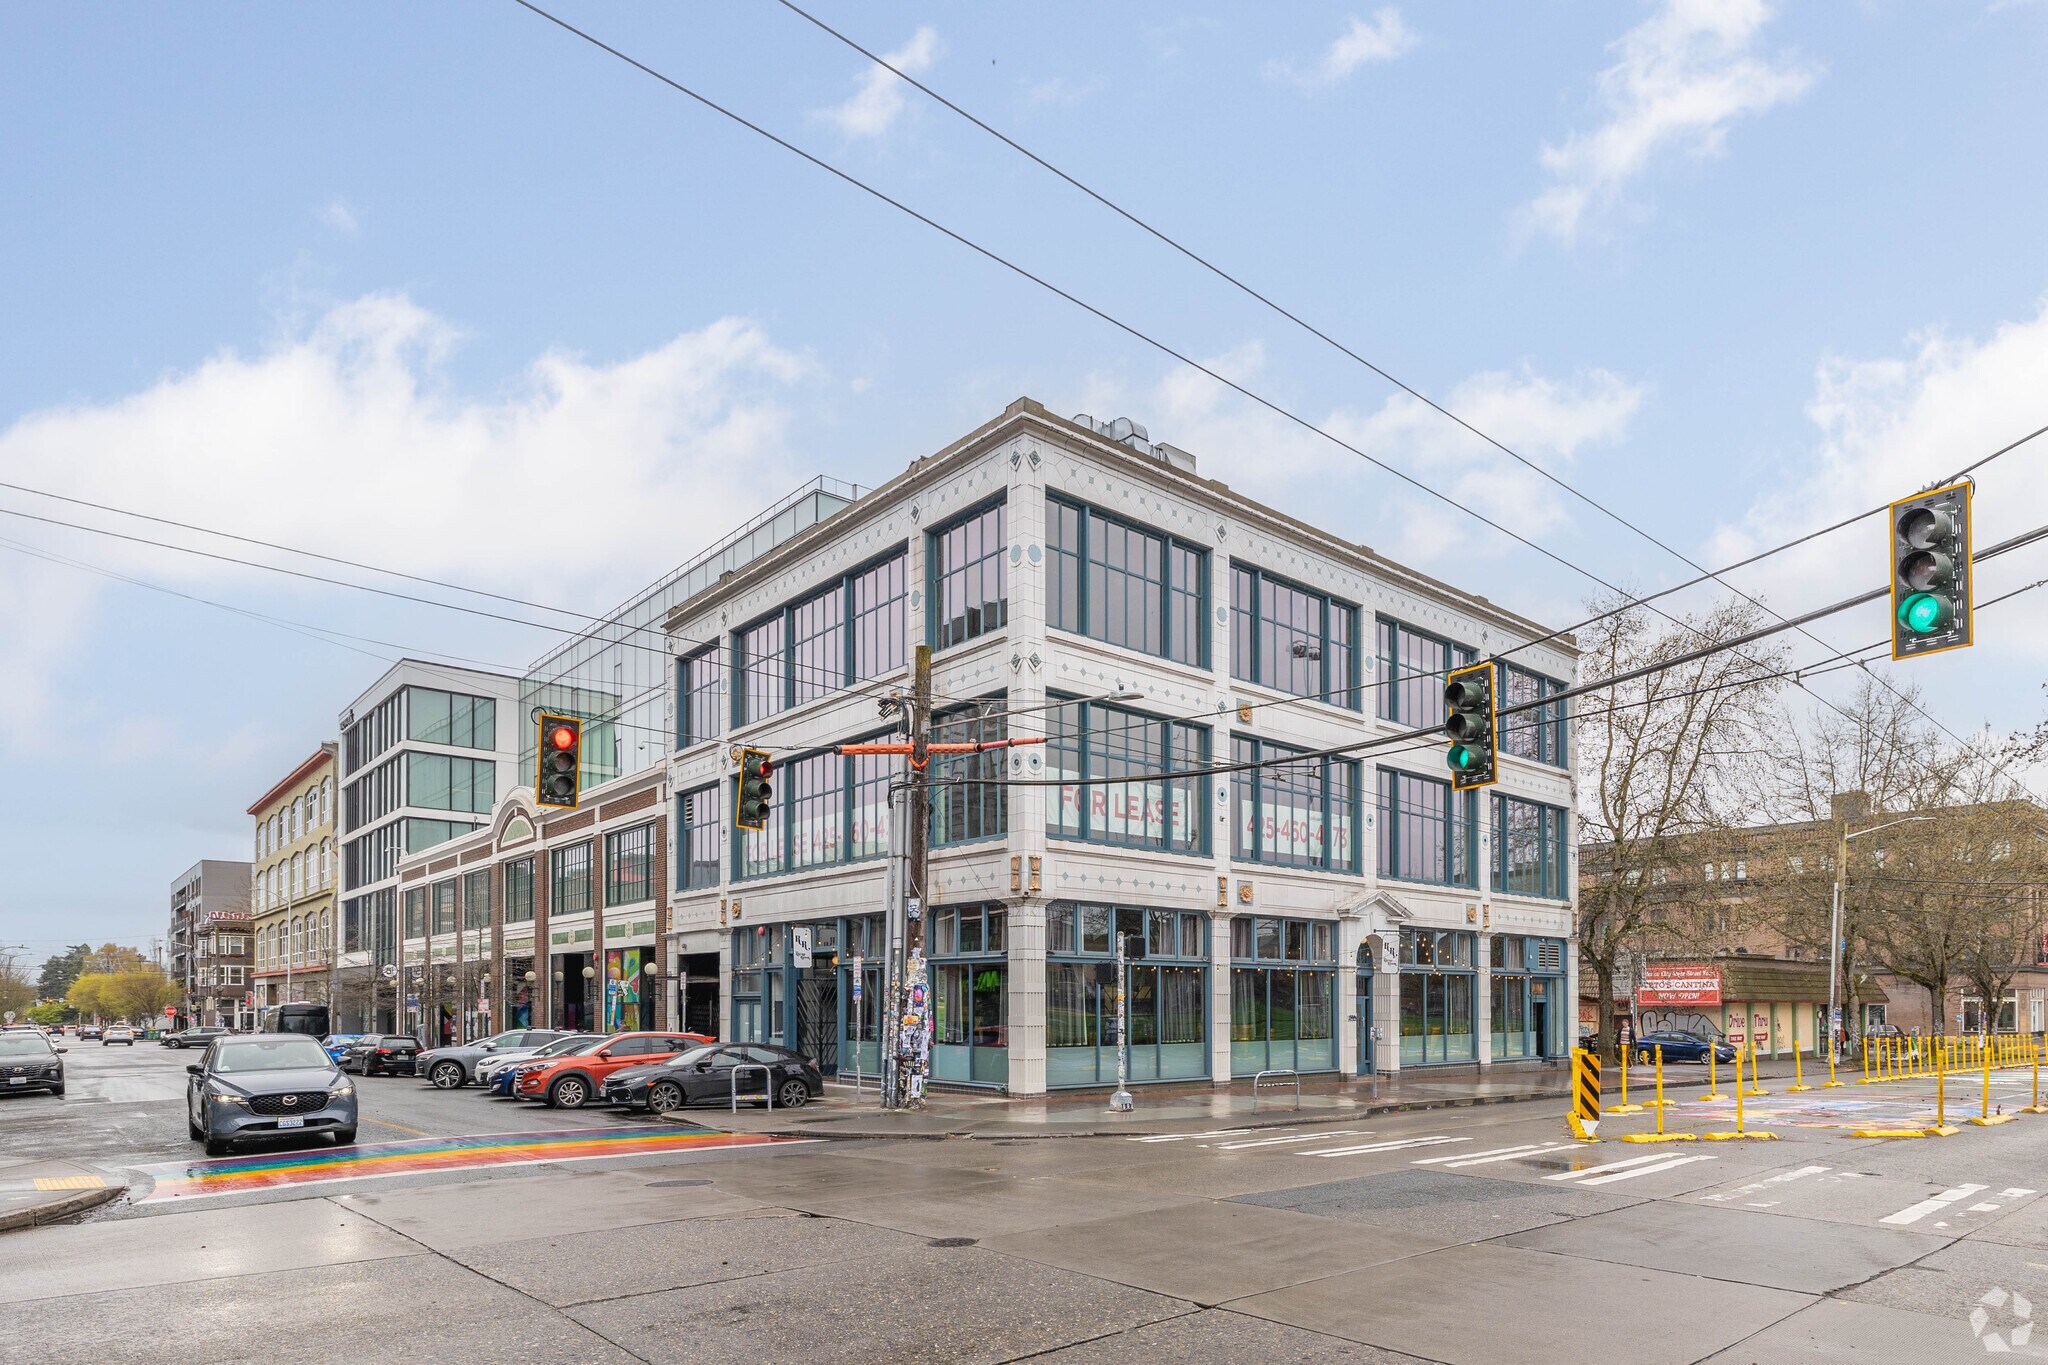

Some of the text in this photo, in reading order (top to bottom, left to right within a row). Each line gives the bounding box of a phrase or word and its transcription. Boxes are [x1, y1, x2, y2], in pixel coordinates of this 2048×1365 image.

[1247, 813, 1347, 849] 45-460-473
[1729, 1013, 1745, 1028] Drive
[1754, 1013, 1768, 1027] Thru
